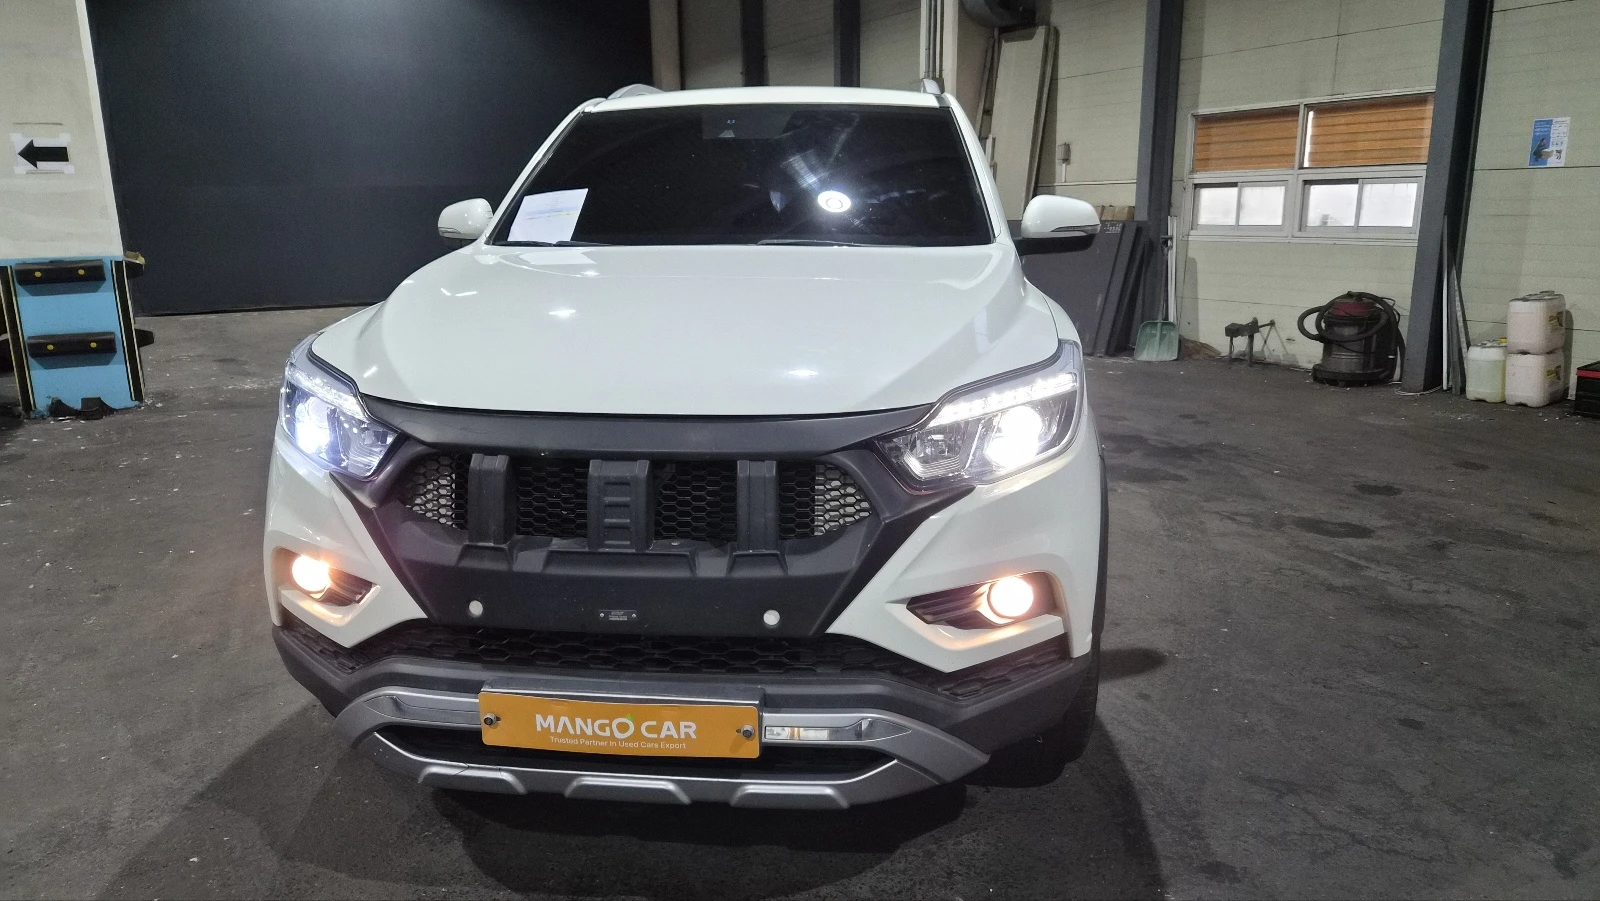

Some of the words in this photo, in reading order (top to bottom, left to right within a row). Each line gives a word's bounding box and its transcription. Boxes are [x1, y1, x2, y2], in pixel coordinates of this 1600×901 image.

[535, 713, 635, 739] MANGO
[640, 720, 697, 739] CAR
[550, 736, 579, 745] Trusted
[580, 738, 608, 747] Partner
[618, 740, 639, 748] Used
[640, 741, 659, 749] Cars
[660, 741, 686, 750] Export
